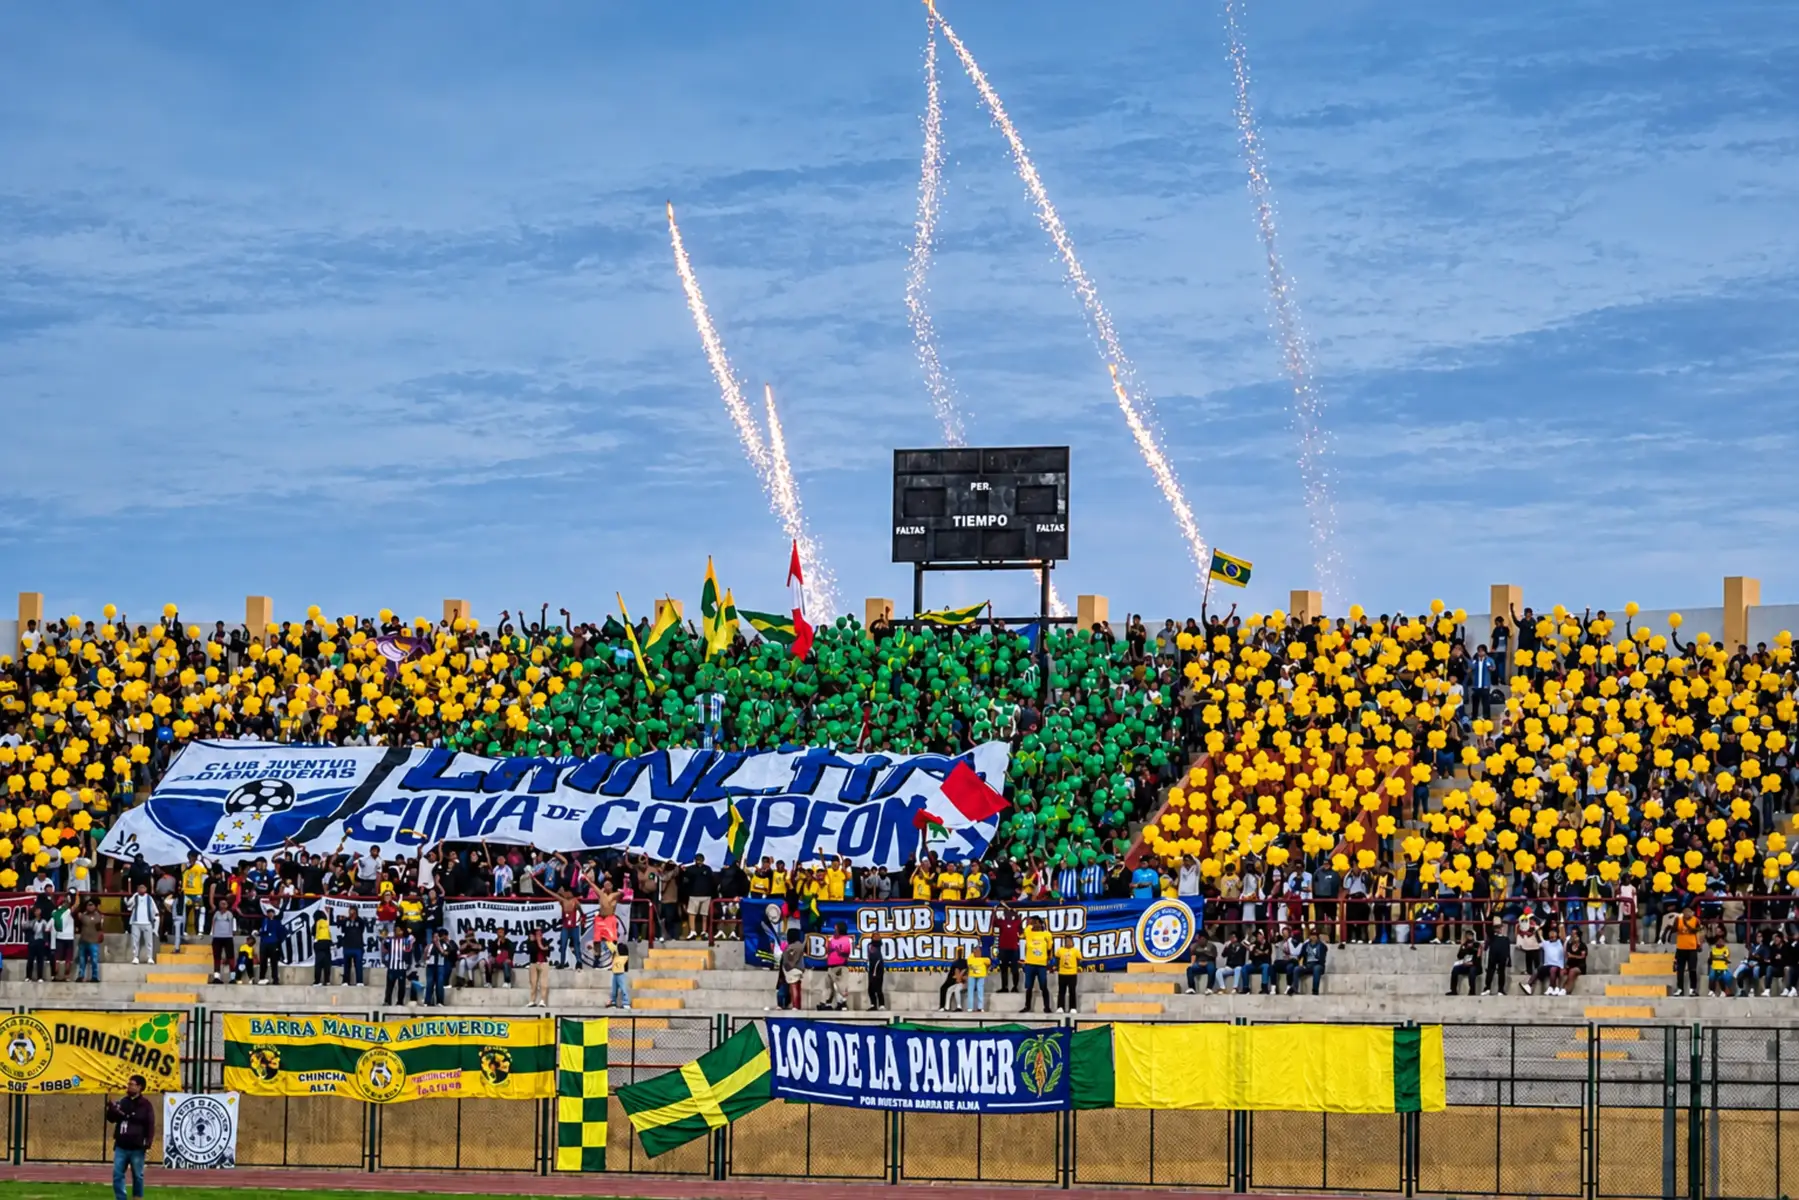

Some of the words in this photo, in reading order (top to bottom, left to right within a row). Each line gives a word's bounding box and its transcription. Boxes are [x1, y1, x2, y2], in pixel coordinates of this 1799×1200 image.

[970, 482, 992, 491] PER.
[952, 514, 1008, 527] TIEMPO
[895, 526, 926, 535] FALTAS
[1036, 524, 1066, 533] FALTAS
[204, 760, 260, 771] CLUB
[343, 795, 540, 846] CUNA
[541, 804, 587, 821] DE
[859, 908, 932, 933] CLUB
[250, 1018, 317, 1037] BARRA
[321, 1018, 392, 1042] MAREA
[396, 1020, 510, 1041] AURIVERDE
[55, 1023, 175, 1077] DIANDERAS
[771, 1024, 820, 1083] LOS
[826, 1031, 863, 1088] DE
[866, 1035, 902, 1091] LA
[906, 1036, 1017, 1095] PALMER
[298, 1072, 347, 1082] CHINCHA
[309, 1083, 337, 1093] ALTA
[859, 1096, 876, 1106] POR
[915, 1099, 943, 1109] BARRA
